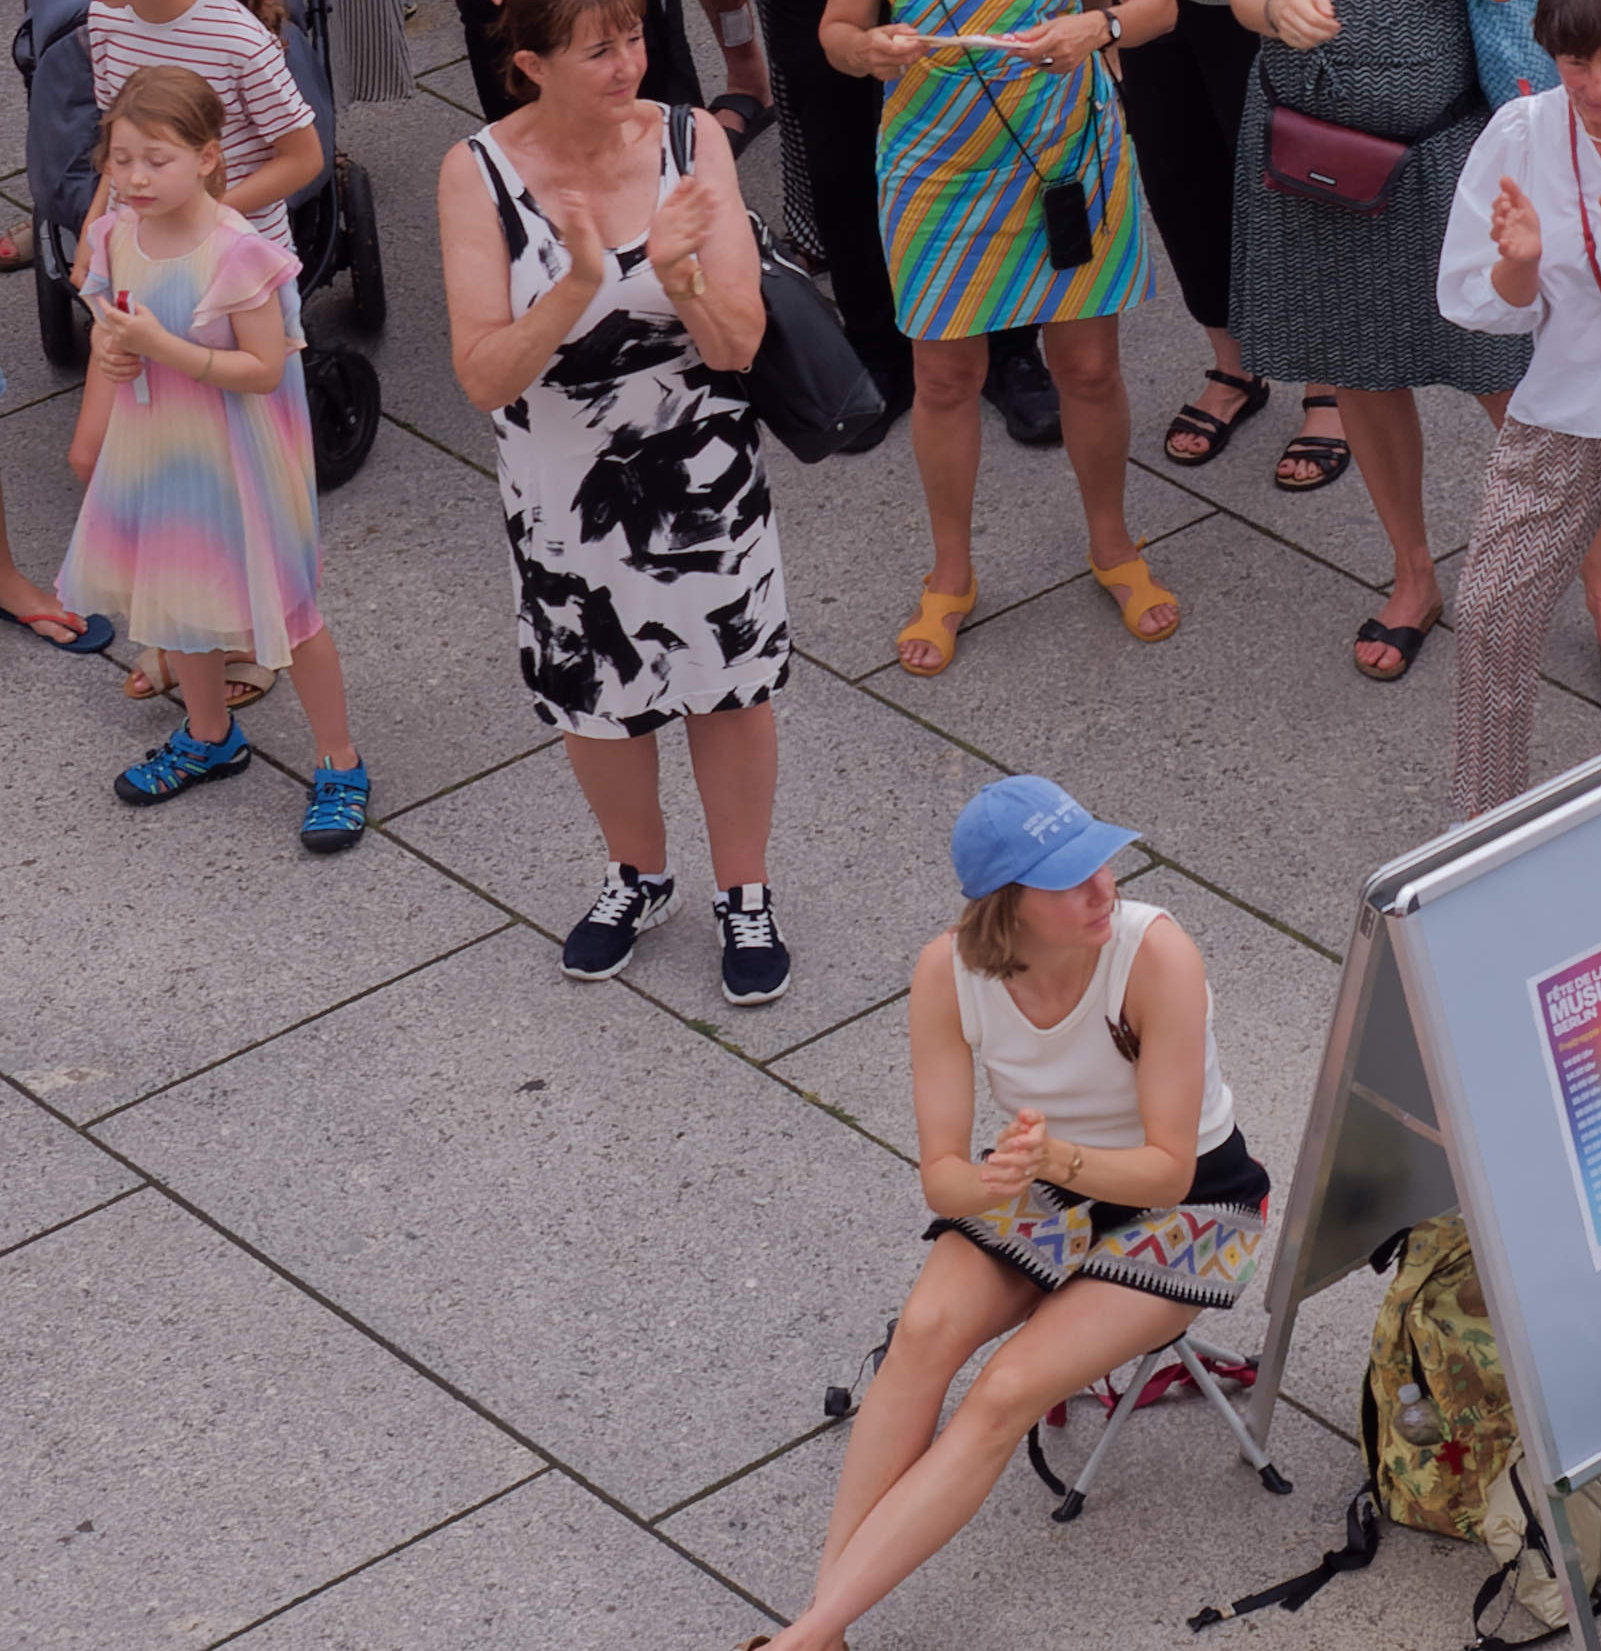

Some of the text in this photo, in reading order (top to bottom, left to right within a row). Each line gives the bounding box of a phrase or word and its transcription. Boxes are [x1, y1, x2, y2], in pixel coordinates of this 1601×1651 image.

[1544, 976, 1575, 1005] FÊTE
[1574, 971, 1592, 990] DE
[1552, 1004, 1598, 1038] BERLIN
